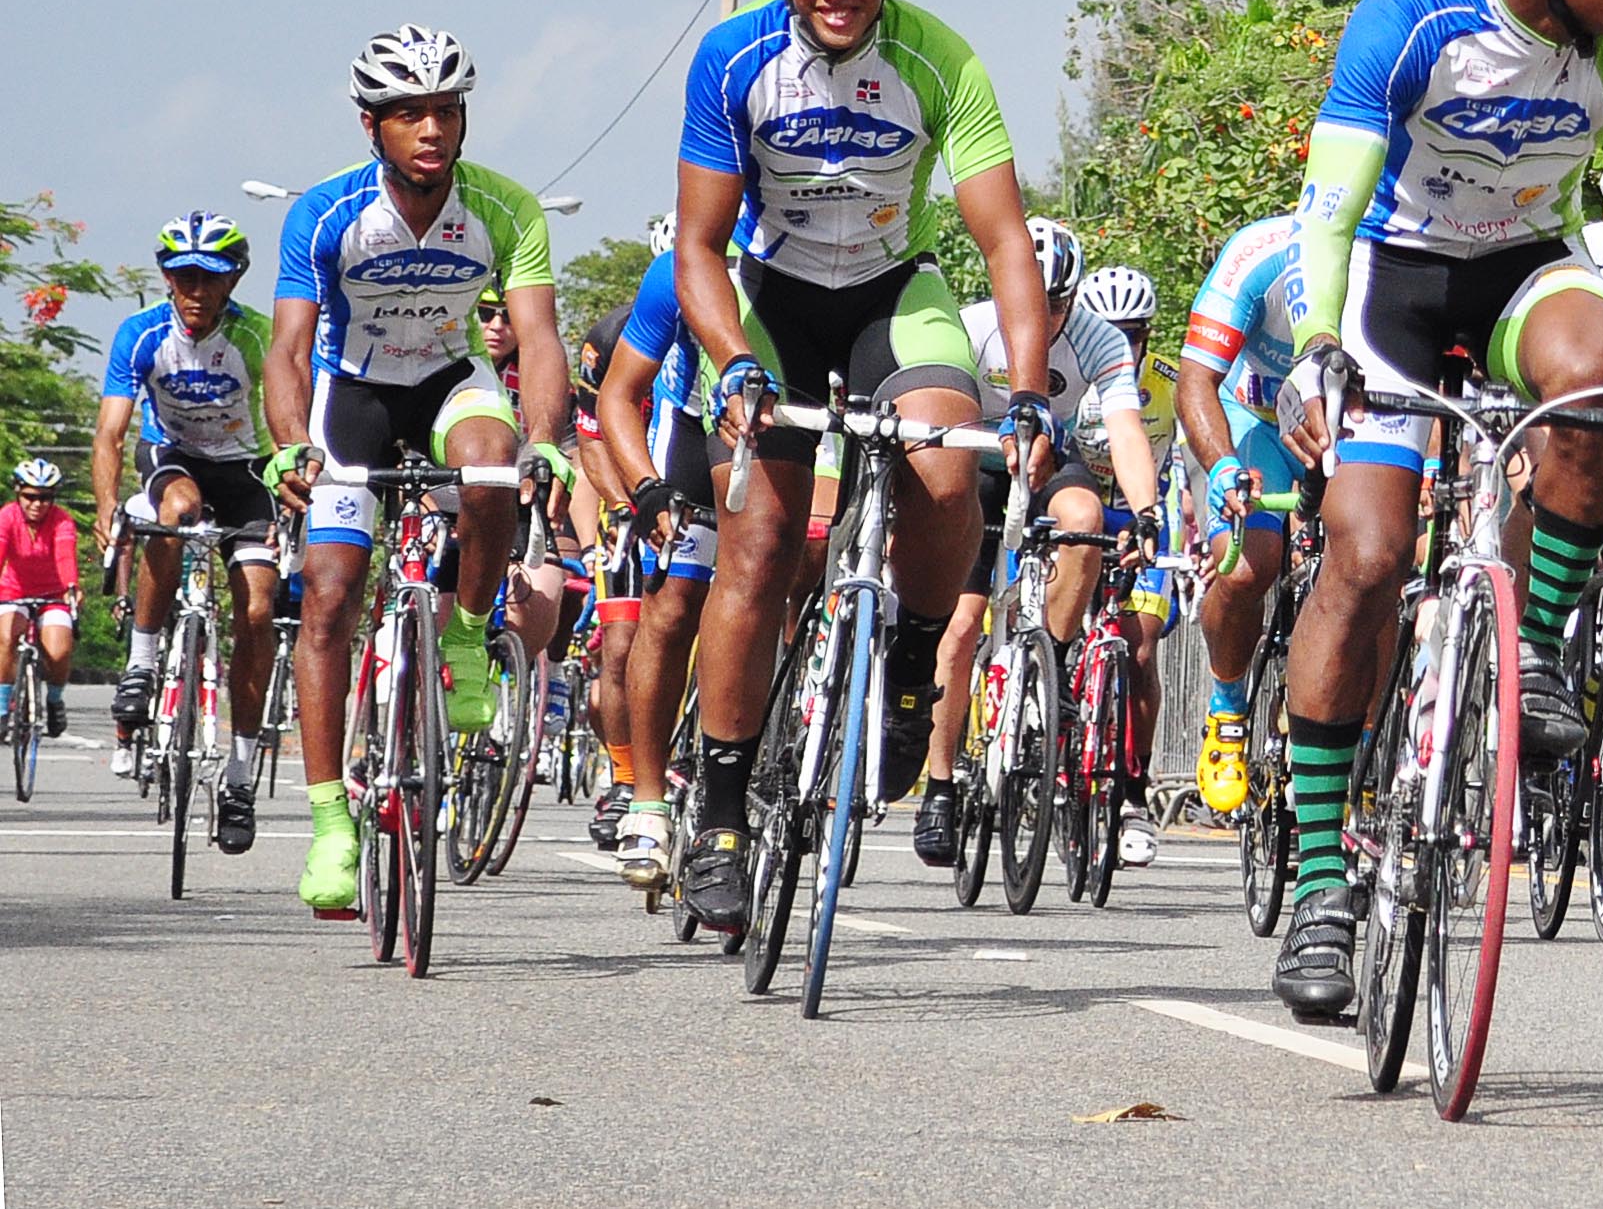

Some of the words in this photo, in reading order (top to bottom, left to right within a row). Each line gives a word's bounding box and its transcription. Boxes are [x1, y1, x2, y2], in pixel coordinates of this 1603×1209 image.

[784, 116, 822, 129] team
[770, 126, 902, 148] CARIBE
[1223, 228, 1290, 288] EUROJUNT
[361, 263, 477, 280] CARIBE
